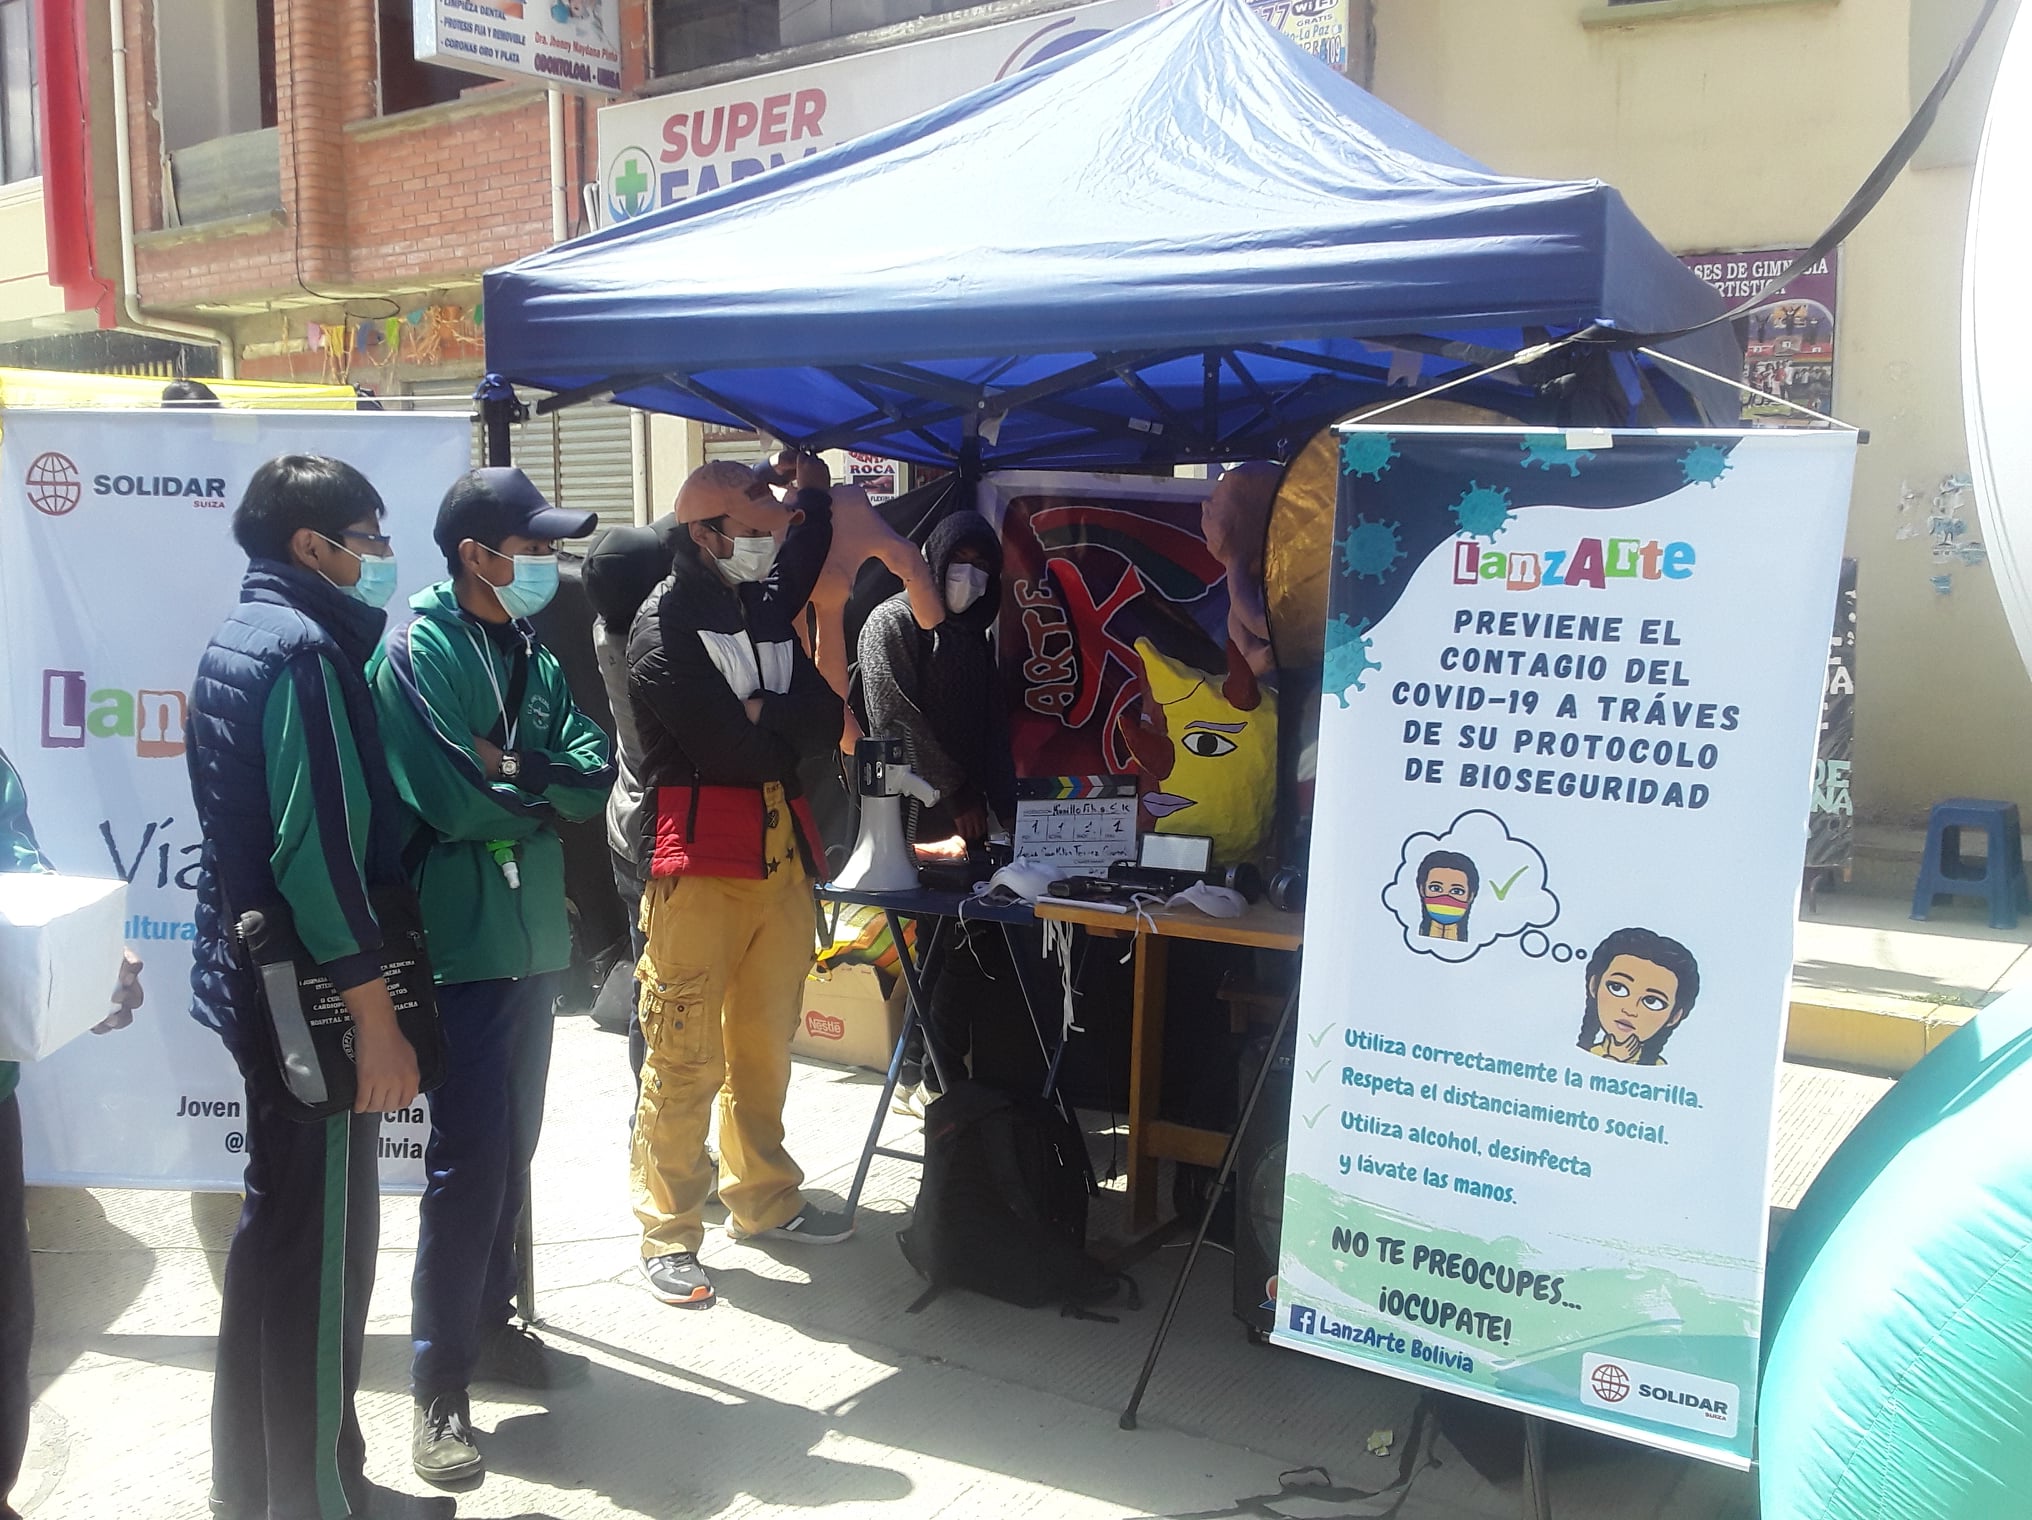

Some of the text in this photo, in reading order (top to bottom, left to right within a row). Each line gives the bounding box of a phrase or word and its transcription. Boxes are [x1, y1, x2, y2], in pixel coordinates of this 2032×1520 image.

[444, 38, 478, 54] CORONAS
[659, 88, 827, 163] SUPER
[1727, 262, 1748, 279] DE
[93, 474, 226, 498] SOLIDAR
[850, 464, 896, 474] ROCA
[193, 500, 225, 508] SUIZA
[1451, 535, 1697, 591] LanzArte
[1453, 609, 1681, 646] PREVIENE EL
[1440, 647, 1690, 687] CONTAGIO DEL
[1391, 681, 1741, 731] COVID-19 A TRÁVES
[1403, 719, 1718, 770] DE SU PROTOCOLO
[1404, 757, 1711, 810] DE BIOSEGURIDAD
[1344, 1027, 1704, 1109] Utiliza correctamente la mascarilla.
[1341, 1066, 1670, 1146] Respeta el distanciamiento social.
[1341, 1110, 1592, 1178] Utiliza alcohol, desinfecta
[1338, 1152, 1517, 1205] y lávate las manos.
[1331, 1226, 1582, 1311] NO TE PREOCUPES...
[1319, 1315, 1405, 1354] LanzArte
[1410, 1338, 1474, 1374] Bolivia
[1638, 1383, 1728, 1416] SOLIDAR
